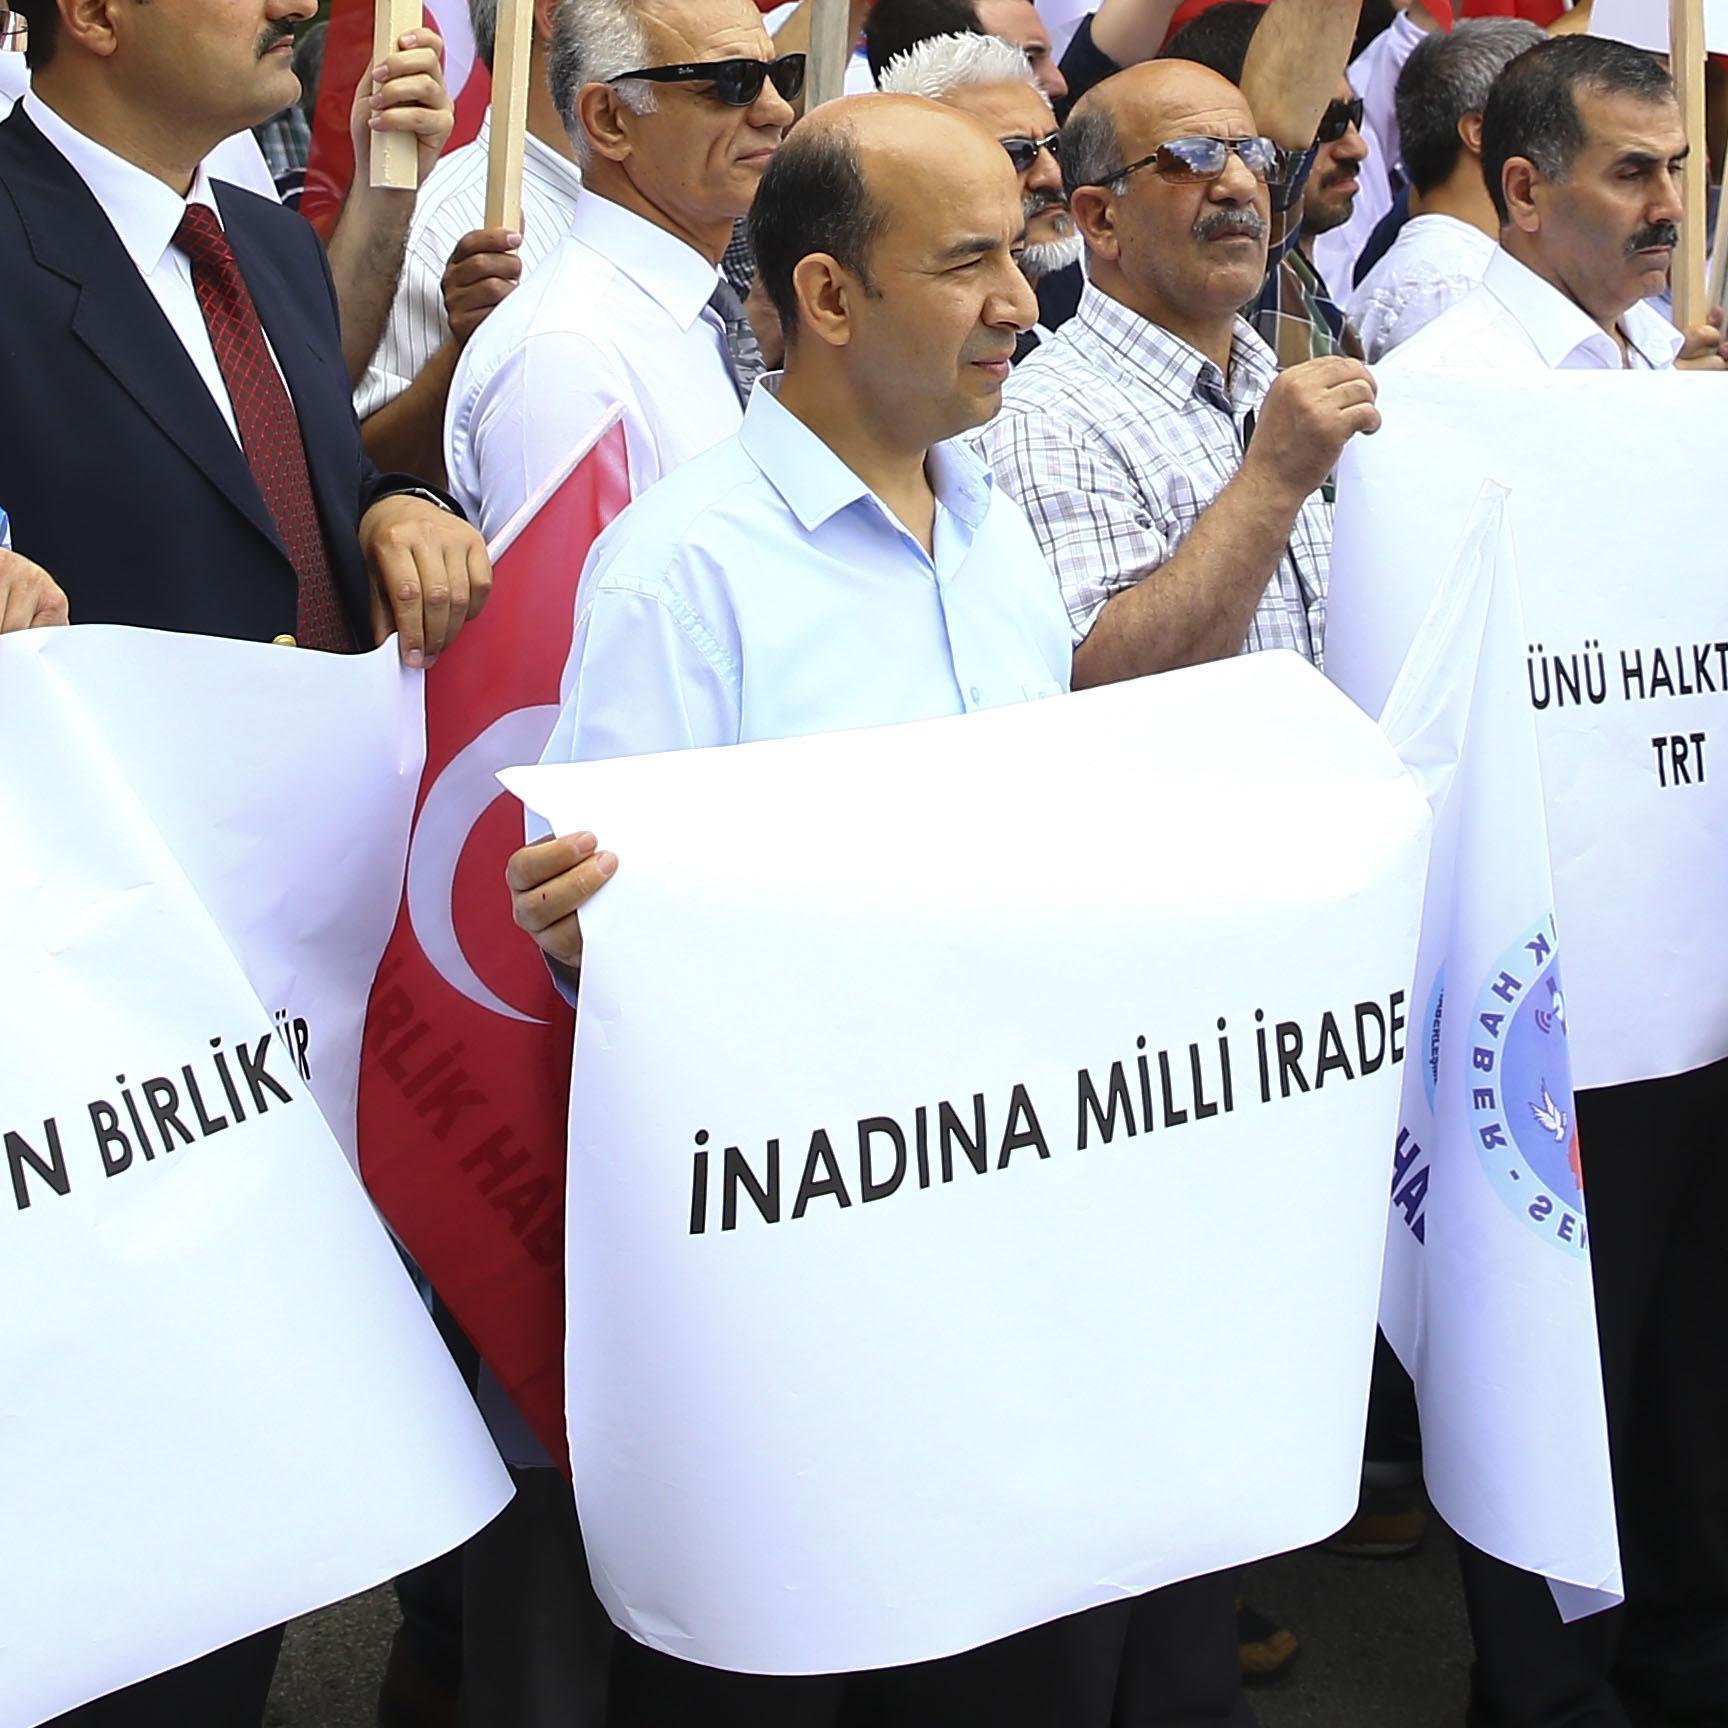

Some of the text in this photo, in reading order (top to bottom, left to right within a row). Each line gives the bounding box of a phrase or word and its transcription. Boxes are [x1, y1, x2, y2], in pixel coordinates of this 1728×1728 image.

[1652, 731, 1707, 789] TRT
[87, 1033, 293, 1179] BİRLİK
[688, 988, 1406, 1236] İNADINA MİLLİ İRADE
